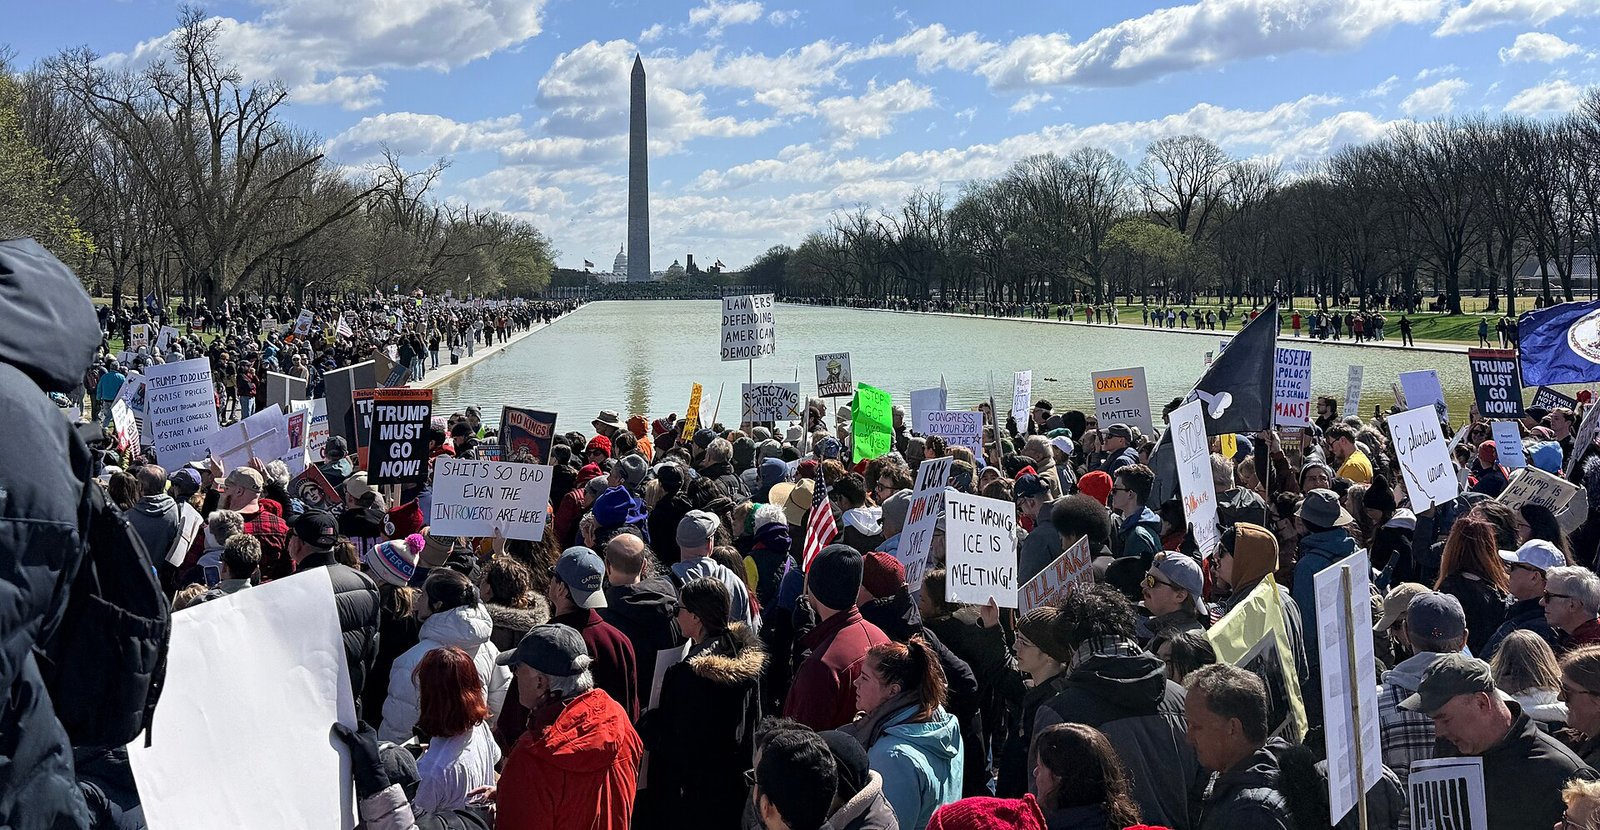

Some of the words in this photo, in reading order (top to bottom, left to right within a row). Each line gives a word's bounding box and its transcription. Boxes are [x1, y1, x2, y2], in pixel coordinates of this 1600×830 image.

[727, 297, 771, 310] LAWYERS
[725, 327, 774, 343] AMERICAN
[722, 343, 775, 358] DEMOCRACY
[1471, 360, 1515, 373] TRUMP
[149, 375, 177, 388] TRUMP
[180, 374, 188, 383] TO
[197, 371, 211, 380] LIST
[1096, 378, 1134, 390] ORANGE
[1478, 374, 1512, 387] MUST
[158, 391, 182, 403] RAISE
[185, 387, 207, 397] PRICES
[743, 386, 798, 404] REJECTING
[819, 382, 852, 396] TYRANNY
[1286, 390, 1309, 400] SCHOOL
[1489, 387, 1508, 400] GO
[756, 396, 784, 407] KINGS
[1099, 396, 1121, 405] LIES
[1485, 401, 1518, 414] NOW!
[1537, 395, 1552, 405] NOT
[1539, 390, 1557, 402] HATE
[1557, 397, 1573, 409] WILL
[161, 416, 185, 427] NEUTER
[185, 412, 212, 422] CONGRESS
[376, 405, 429, 422] TRUMP
[510, 412, 522, 424] NO
[928, 412, 976, 424] CONGRESS,
[1101, 408, 1142, 420] MATTER
[1275, 401, 1310, 423] MANS!
[164, 429, 185, 440] START
[194, 424, 209, 433] WAR
[380, 423, 424, 440] MUST
[523, 416, 547, 436] KINGS
[929, 424, 939, 433] DO
[940, 424, 960, 434] YOUR
[960, 424, 978, 434] JOB!
[165, 441, 192, 452] CONTROL
[193, 438, 206, 446] ELEC
[958, 436, 971, 444] THE
[389, 442, 412, 459] GO
[379, 460, 421, 477] NOW!
[442, 461, 490, 479] SHIT'S
[494, 465, 513, 480] SO
[519, 467, 544, 482] BAD
[921, 460, 948, 491] LOCK
[1519, 469, 1549, 494] Trump
[1552, 484, 1562, 496] is
[463, 483, 494, 499] EVEN
[501, 487, 522, 501] THE
[434, 503, 493, 521] INTROVERTS
[496, 508, 518, 522] ARE
[519, 510, 542, 524] HERE
[948, 500, 976, 522] THE
[980, 507, 1013, 532] WRONG
[963, 533, 983, 553] ICE
[989, 534, 1001, 553] IS
[381, 545, 403, 570] NTER
[1051, 540, 1091, 586] TAKE
[951, 563, 1013, 590] MELTING!
